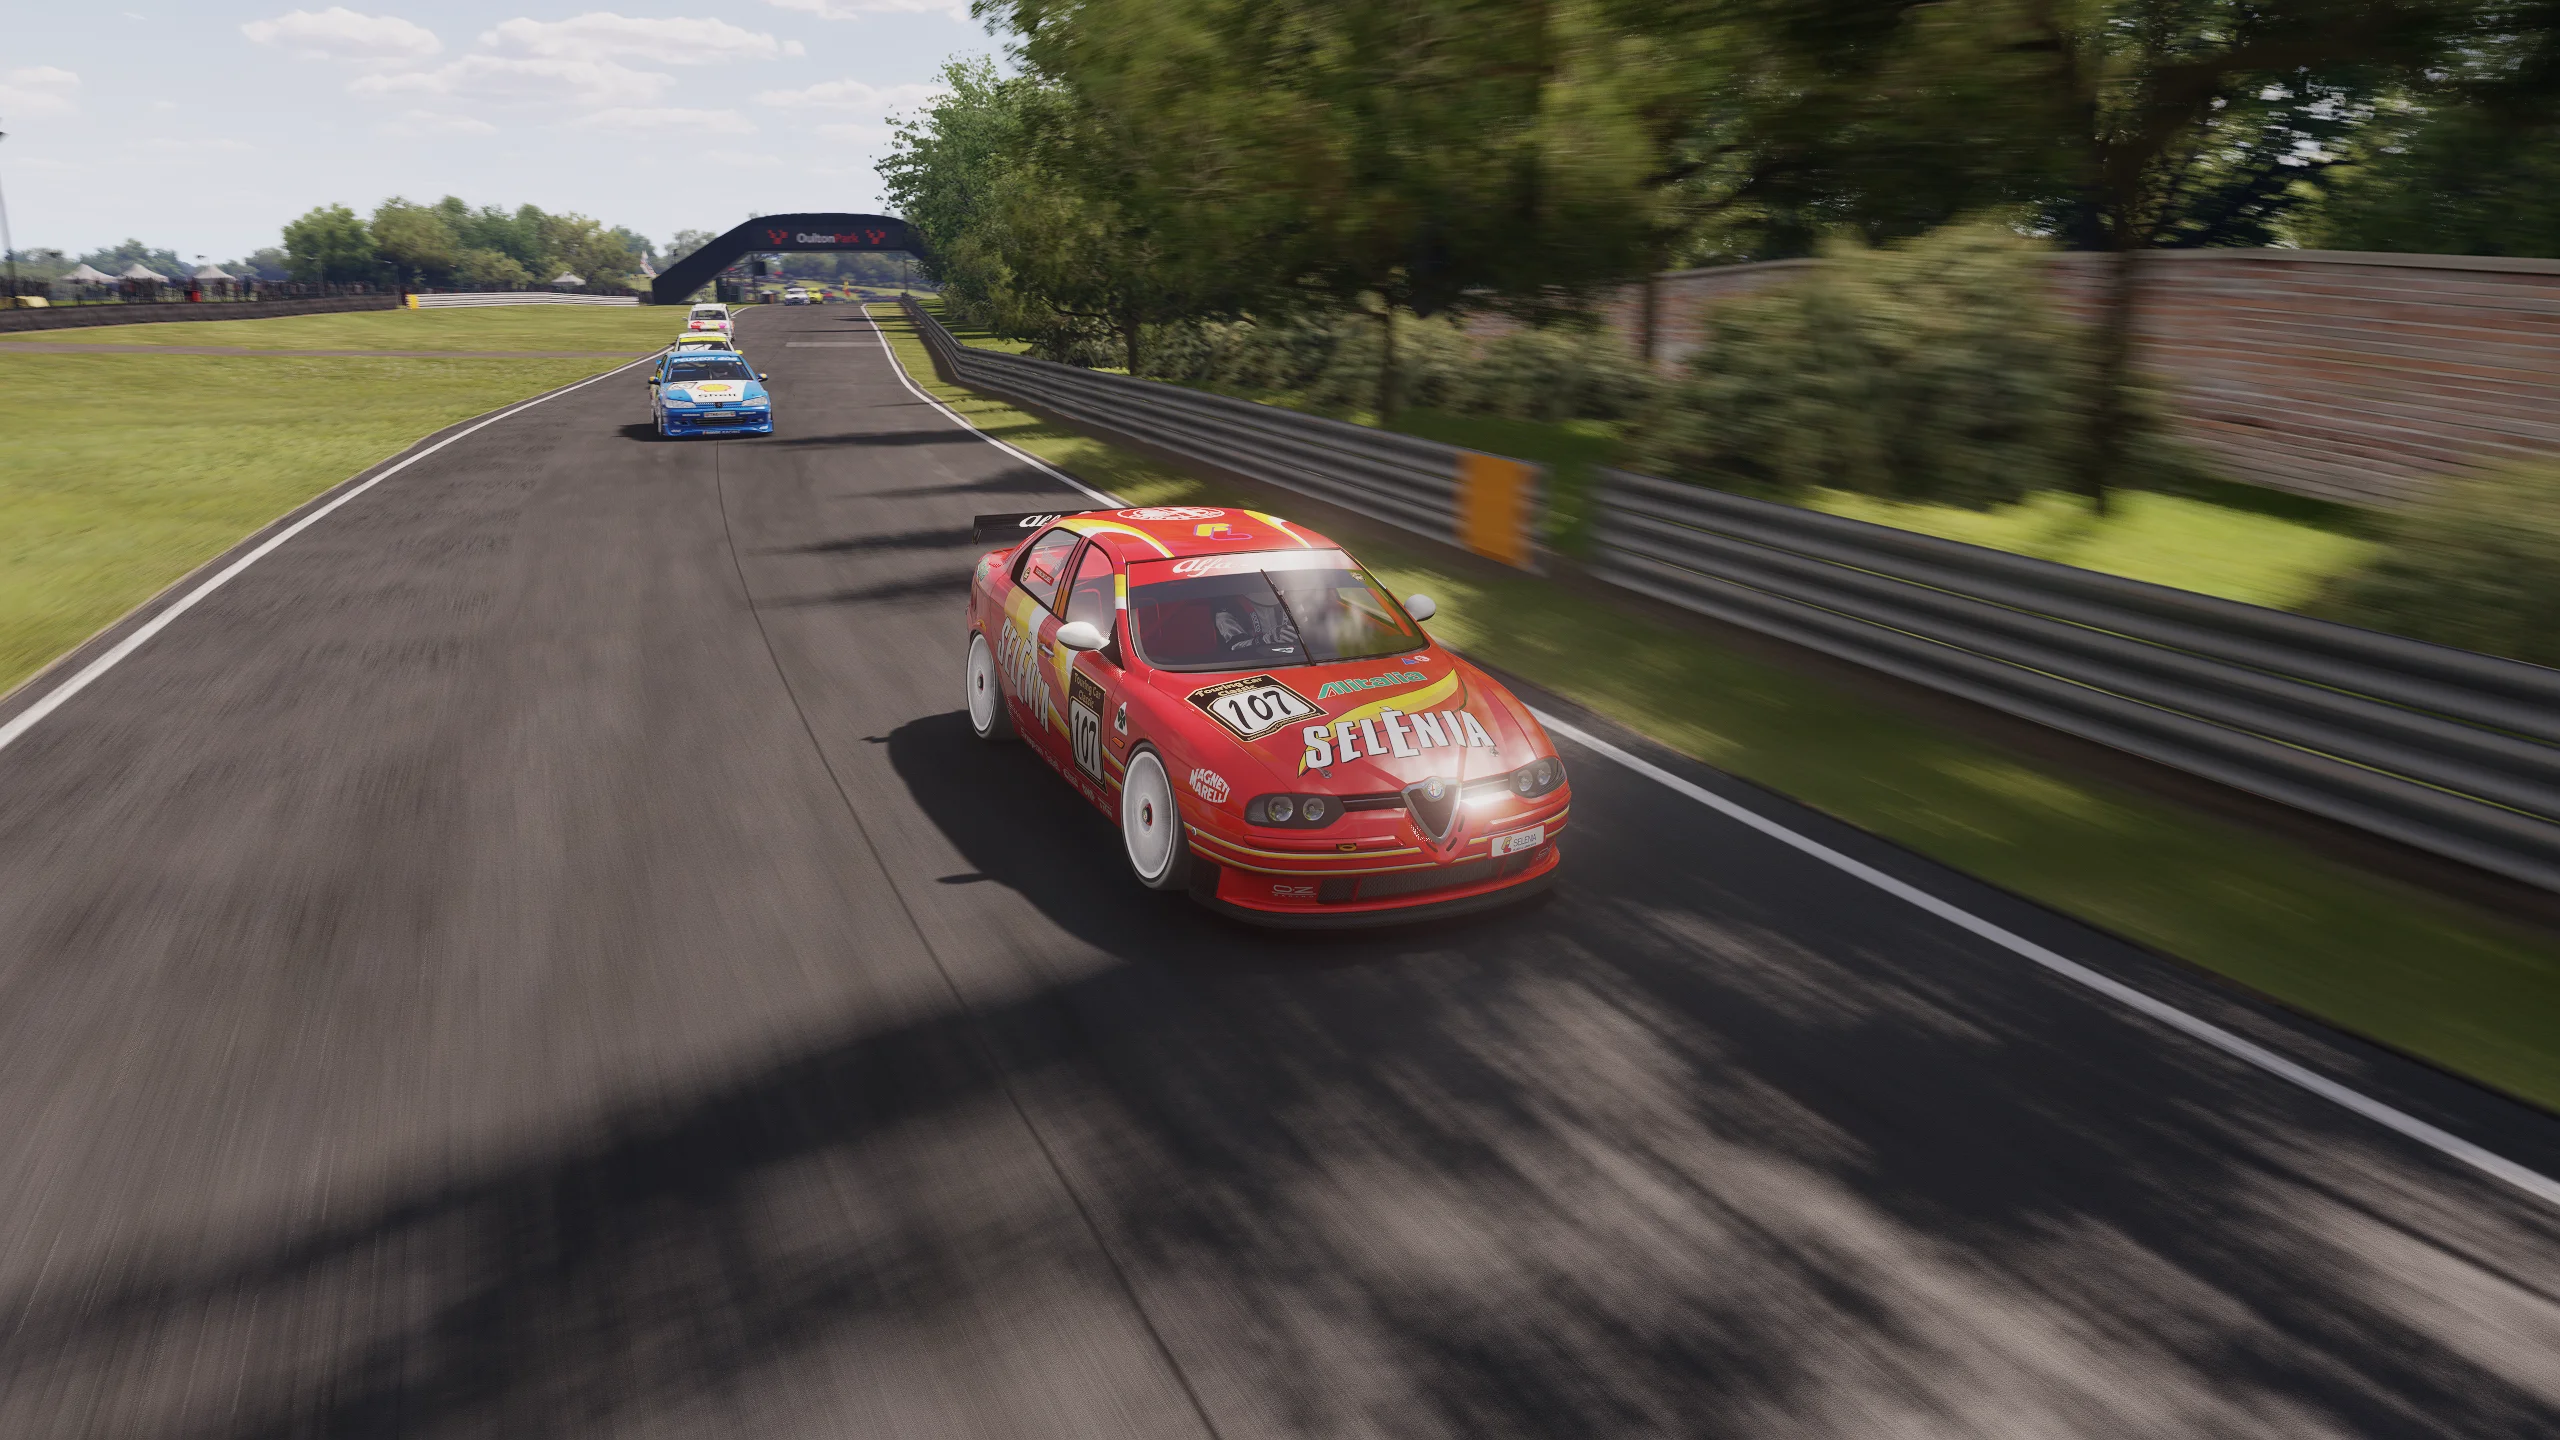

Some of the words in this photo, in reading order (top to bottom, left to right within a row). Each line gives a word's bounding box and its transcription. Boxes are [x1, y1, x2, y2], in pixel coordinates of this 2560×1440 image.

[1074, 672, 1093, 697] Touring
[1195, 680, 1244, 698] Touring
[1243, 677, 1263, 686] Car
[1217, 684, 1258, 697] Classic
[1317, 671, 1428, 701] Alitalia
[1078, 690, 1095, 709] Classic
[1228, 690, 1292, 730] 107
[1074, 710, 1097, 771] 107
[1189, 776, 1230, 803] MARELLI
